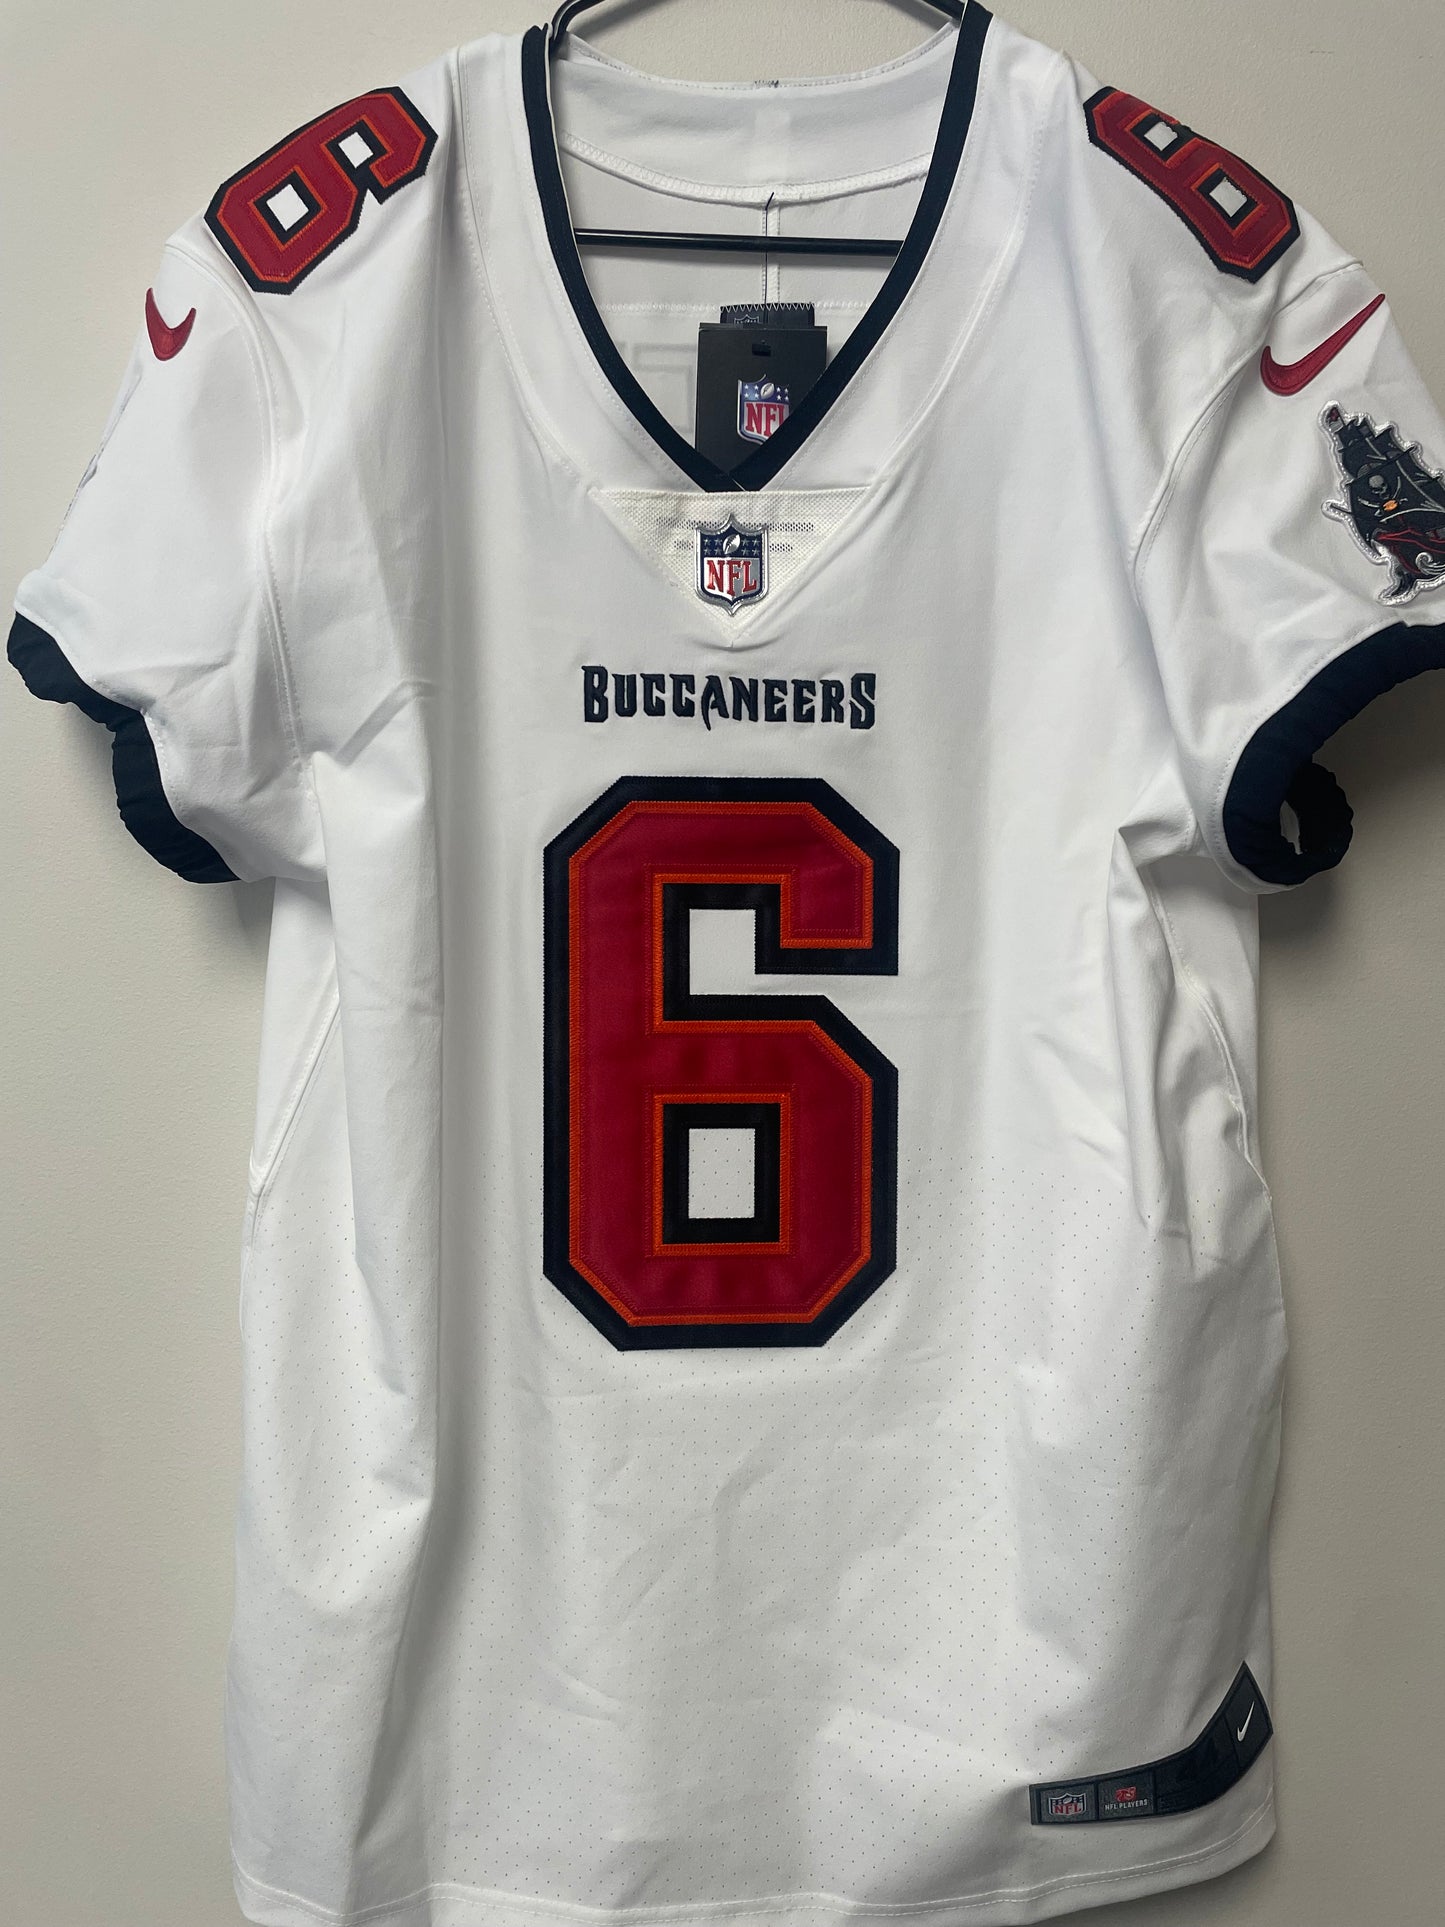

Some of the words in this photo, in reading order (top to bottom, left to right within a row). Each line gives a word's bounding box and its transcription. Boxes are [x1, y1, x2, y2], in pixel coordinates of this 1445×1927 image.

[204, 86, 438, 294] 6
[1083, 86, 1301, 284] 6
[706, 560, 757, 596] NFL
[581, 665, 876, 731] BUCCANEERS
[543, 776, 899, 1351] 6
[1054, 1803, 1082, 1814] NFL
[1119, 1799, 1148, 1809] PLAYERS
